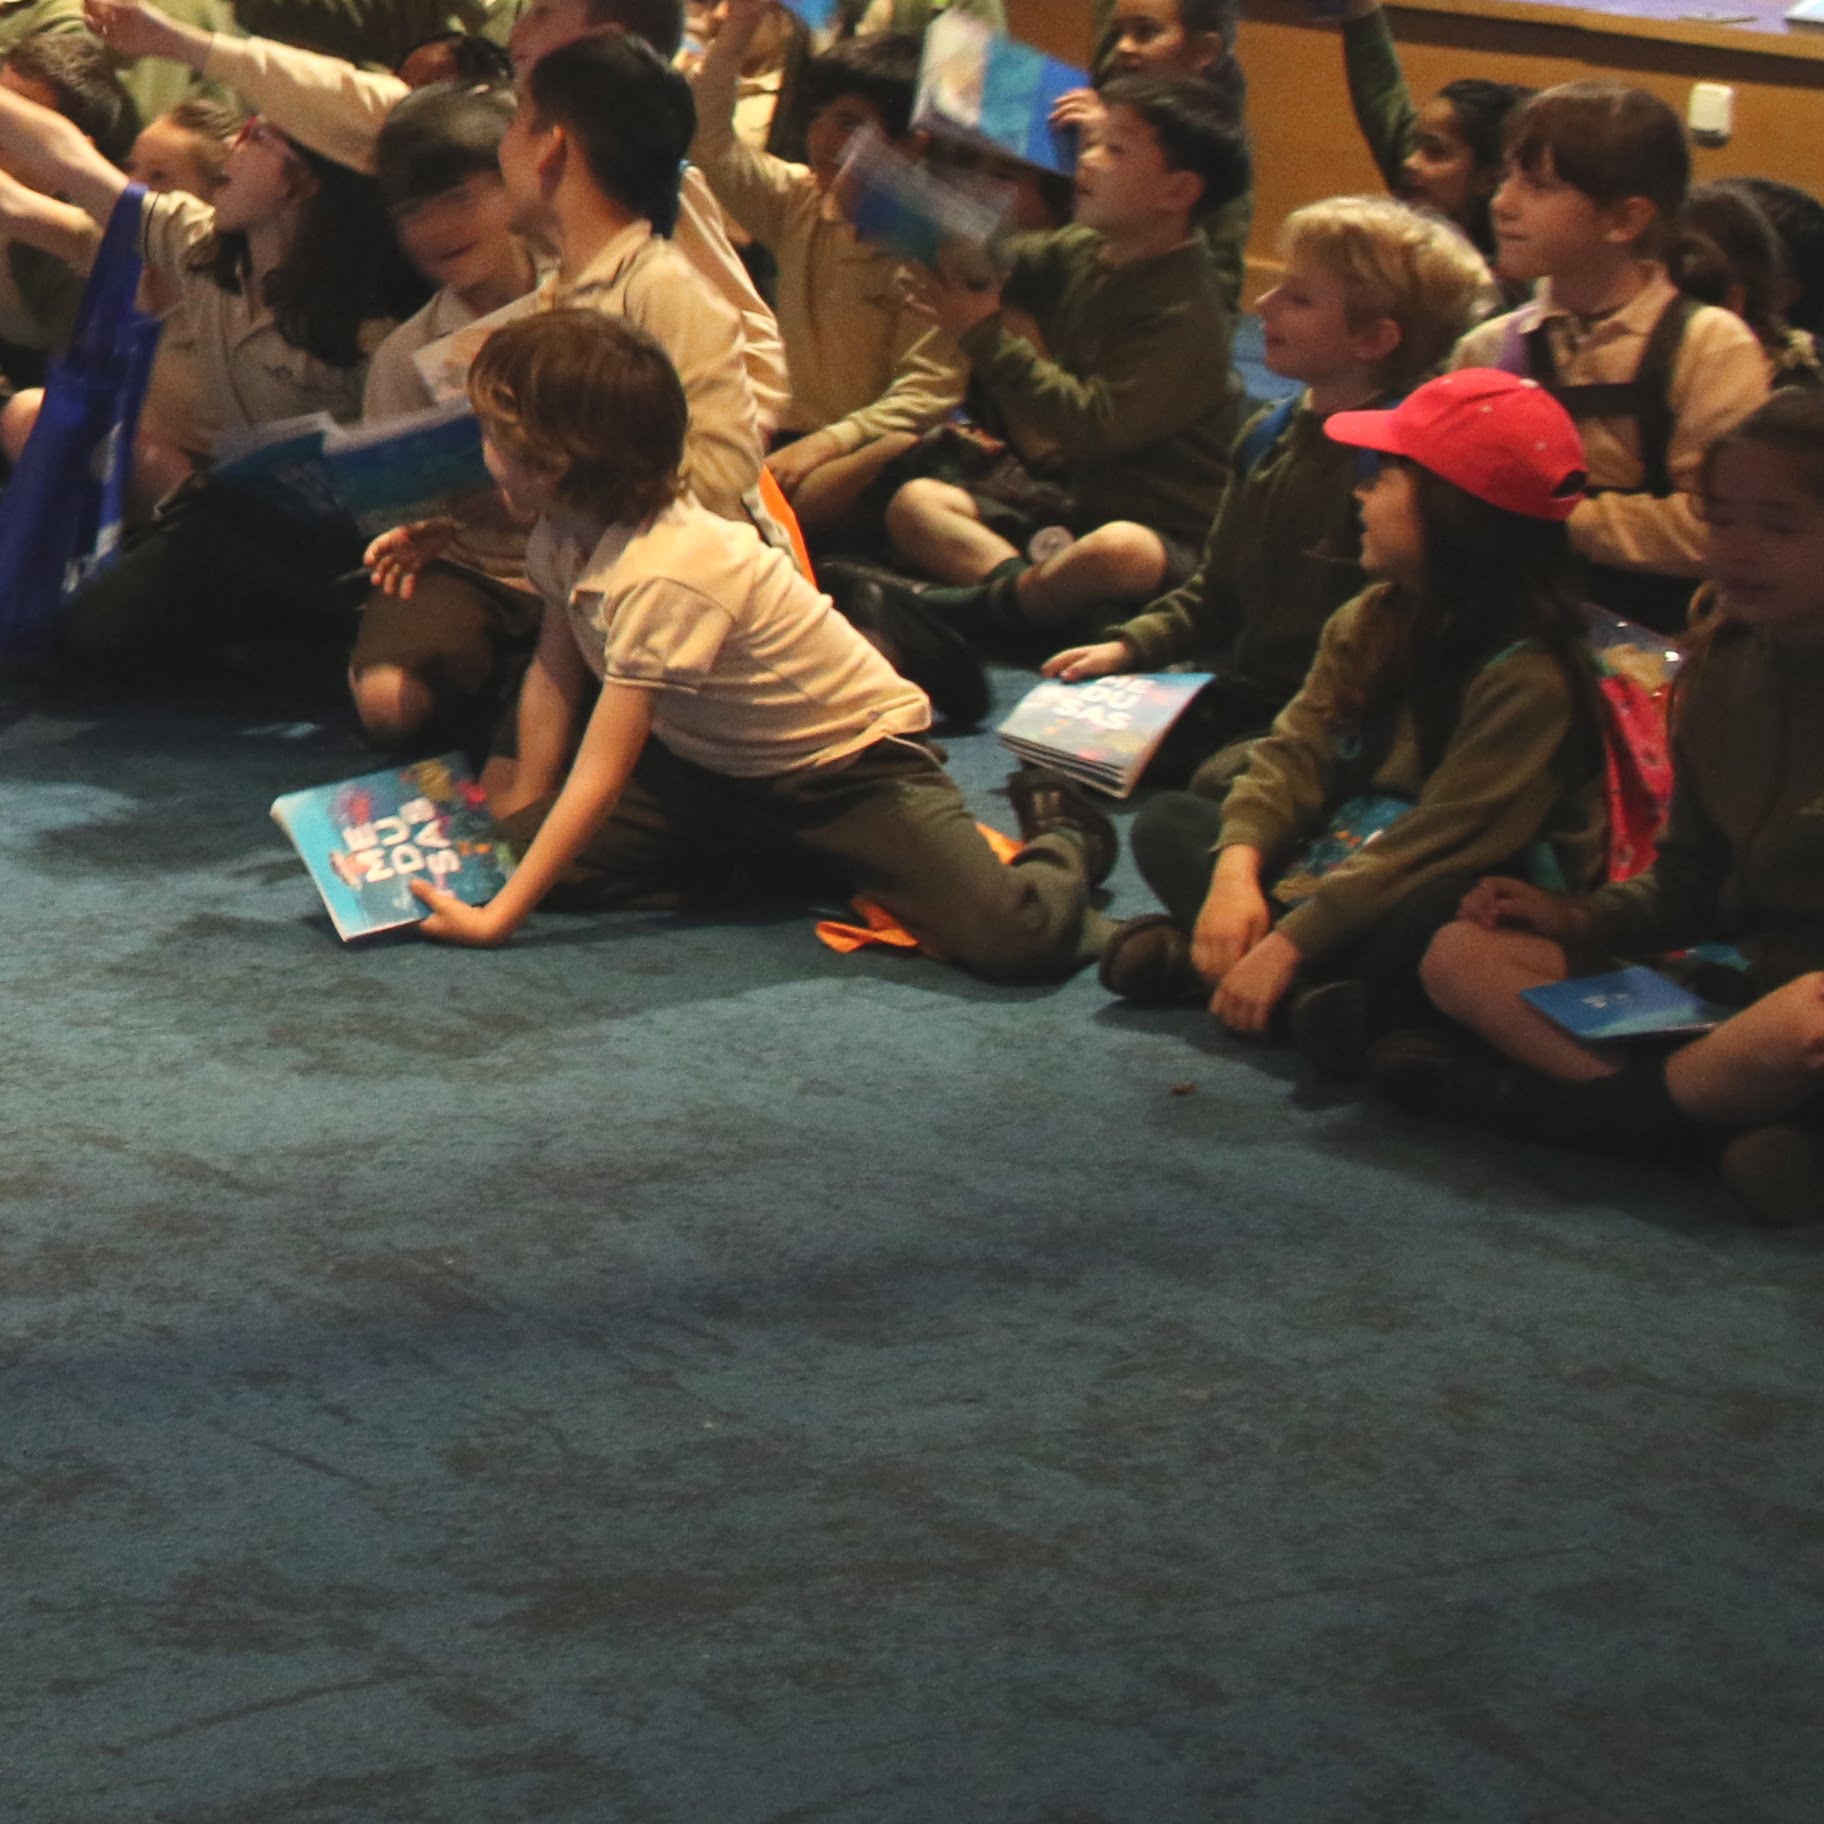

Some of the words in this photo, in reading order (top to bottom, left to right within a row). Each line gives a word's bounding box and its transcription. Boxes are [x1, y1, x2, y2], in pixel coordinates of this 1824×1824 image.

[1052, 697, 1134, 732] SAS
[1078, 685, 1145, 711] DU
[341, 821, 397, 884] ME
[373, 815, 426, 876] DU
